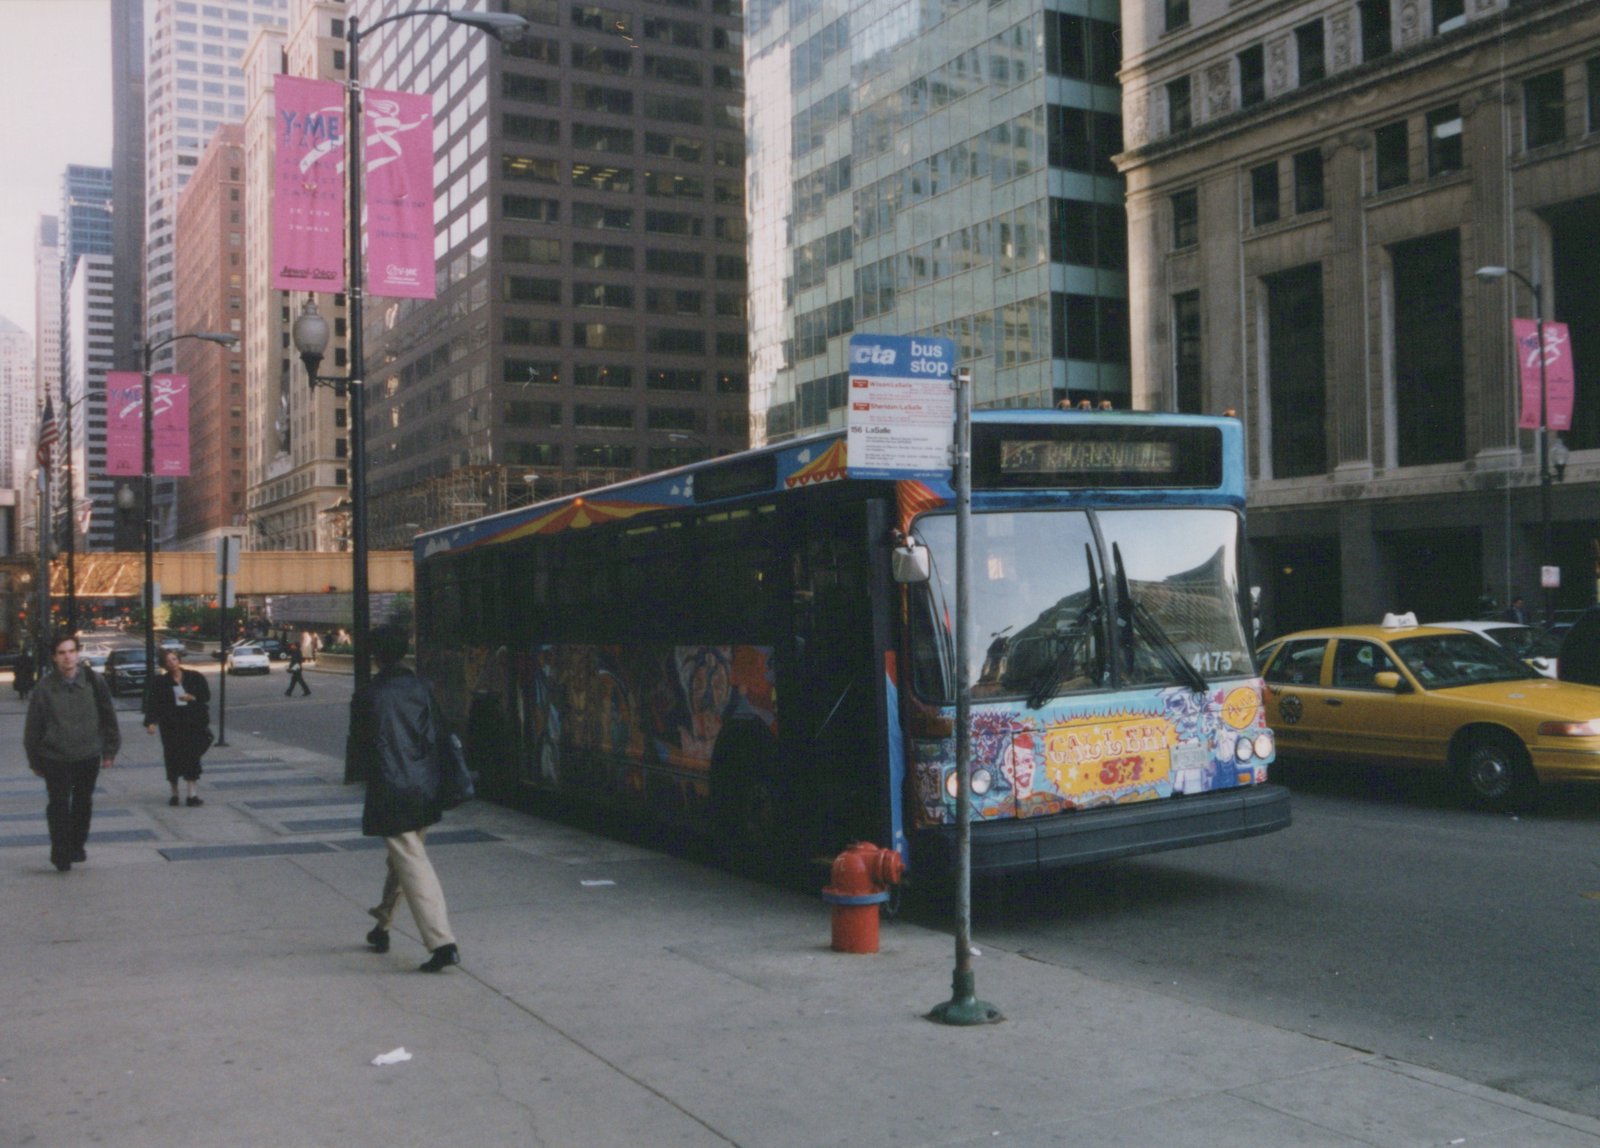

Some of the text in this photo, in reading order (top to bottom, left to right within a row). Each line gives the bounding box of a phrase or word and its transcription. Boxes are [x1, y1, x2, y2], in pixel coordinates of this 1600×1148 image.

[281, 109, 340, 141] Y-ME
[855, 344, 897, 365] cta
[911, 340, 943, 358] bus
[910, 358, 948, 377] stop
[865, 426, 891, 434] LaSalle
[1192, 651, 1233, 673] 4175
[1048, 724, 1170, 764] GALLERY
